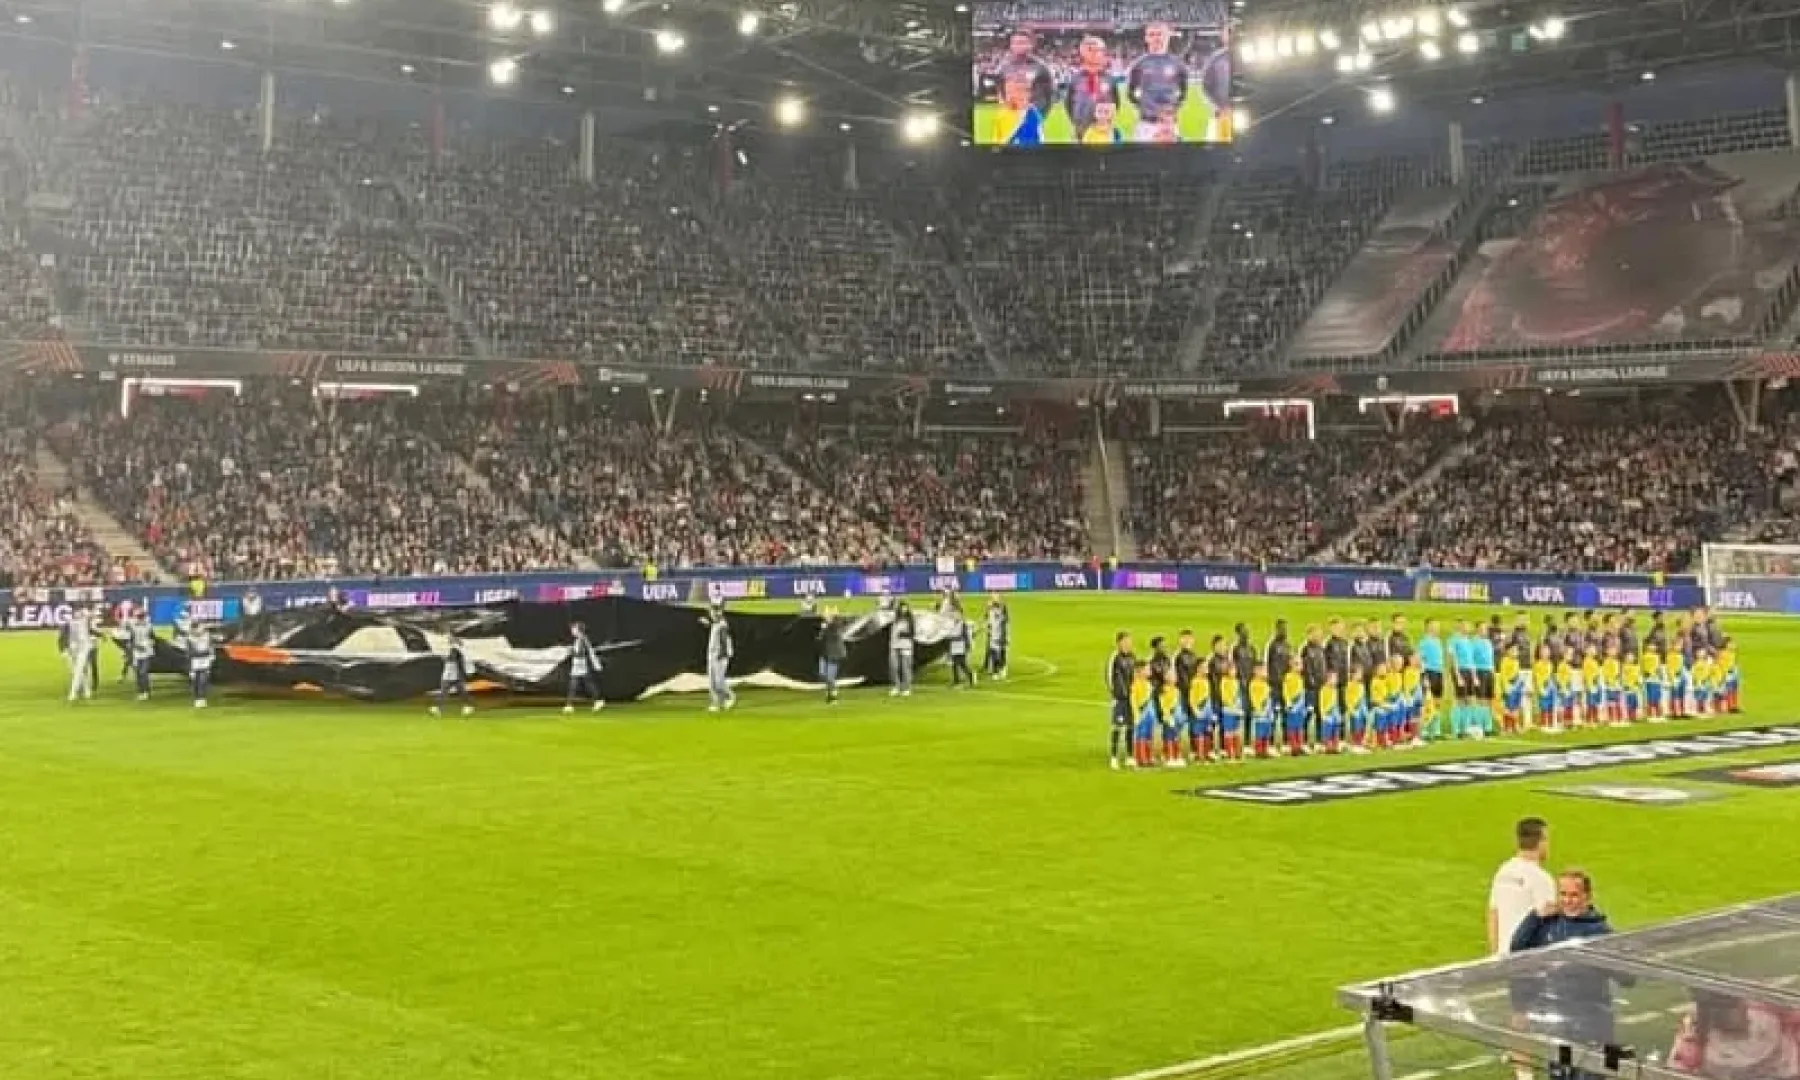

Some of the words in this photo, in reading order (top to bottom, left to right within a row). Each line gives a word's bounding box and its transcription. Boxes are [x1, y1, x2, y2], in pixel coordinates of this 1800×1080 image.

[793, 579, 826, 595] UEFA
[1203, 574, 1239, 591] UEFA
[1353, 579, 1392, 596] UEFA
[643, 584, 678, 600] UEFA
[1522, 586, 1565, 603] UEFA
